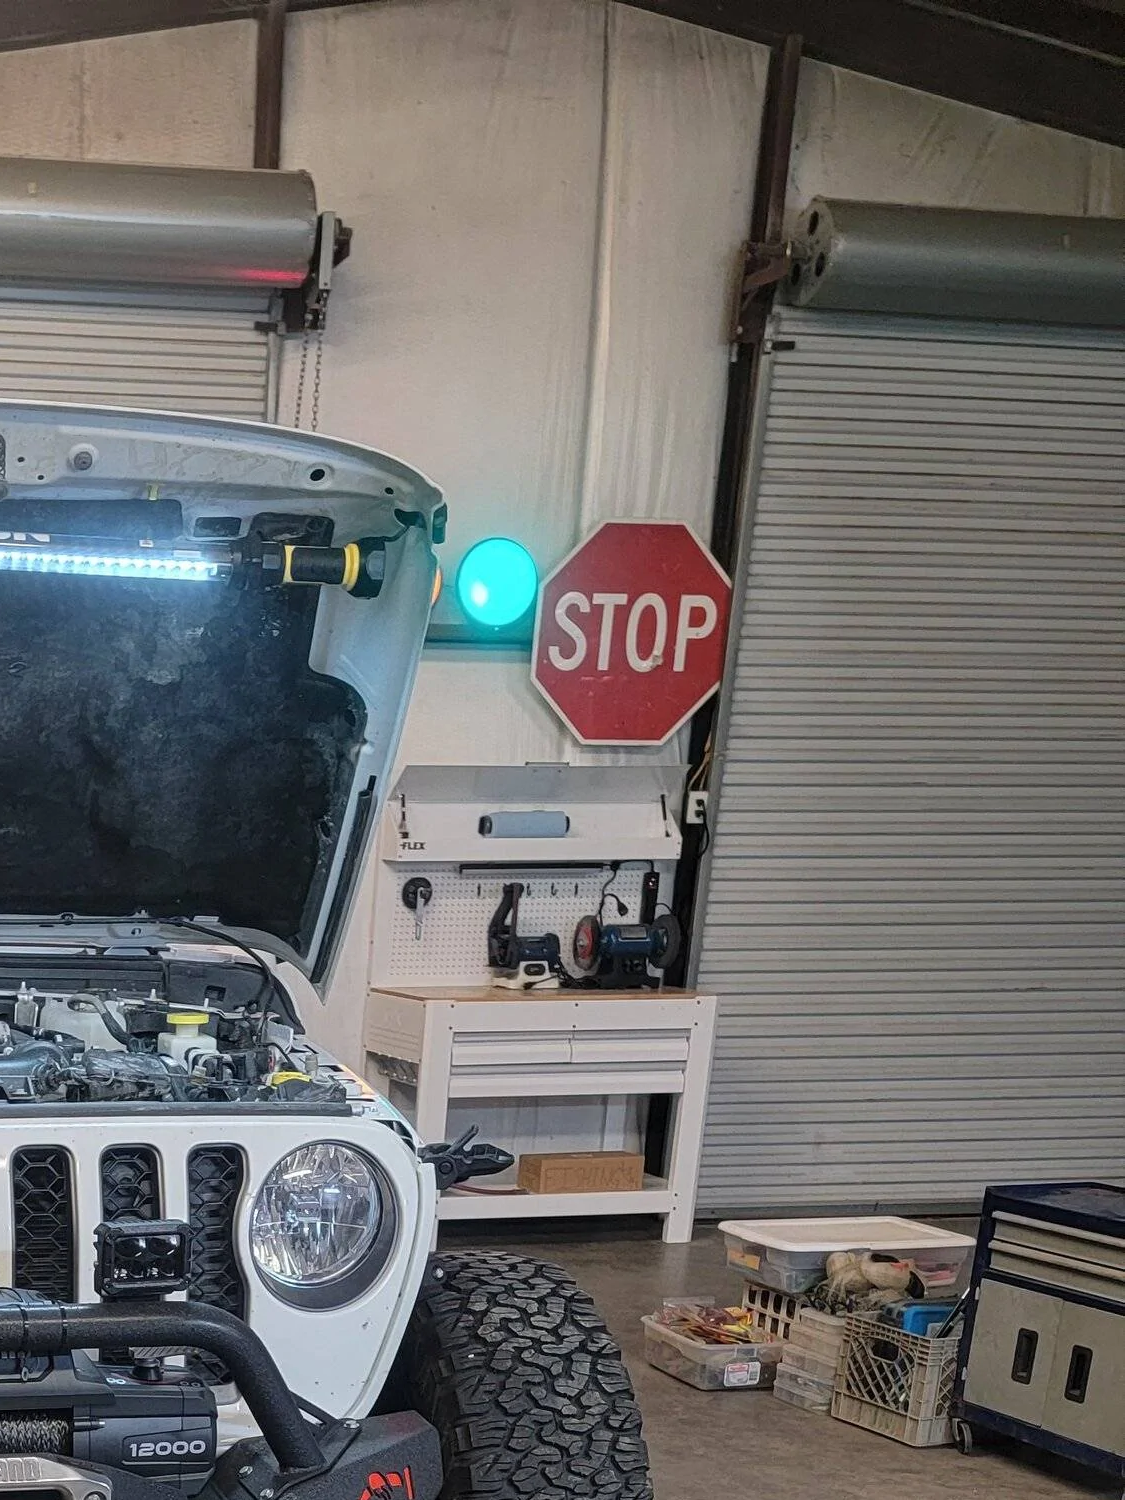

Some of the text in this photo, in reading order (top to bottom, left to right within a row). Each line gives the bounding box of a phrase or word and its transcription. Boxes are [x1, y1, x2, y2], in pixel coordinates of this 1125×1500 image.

[547, 591, 718, 673] STOP
[400, 842, 425, 850] FLEX
[128, 1440, 207, 1459] 12000
